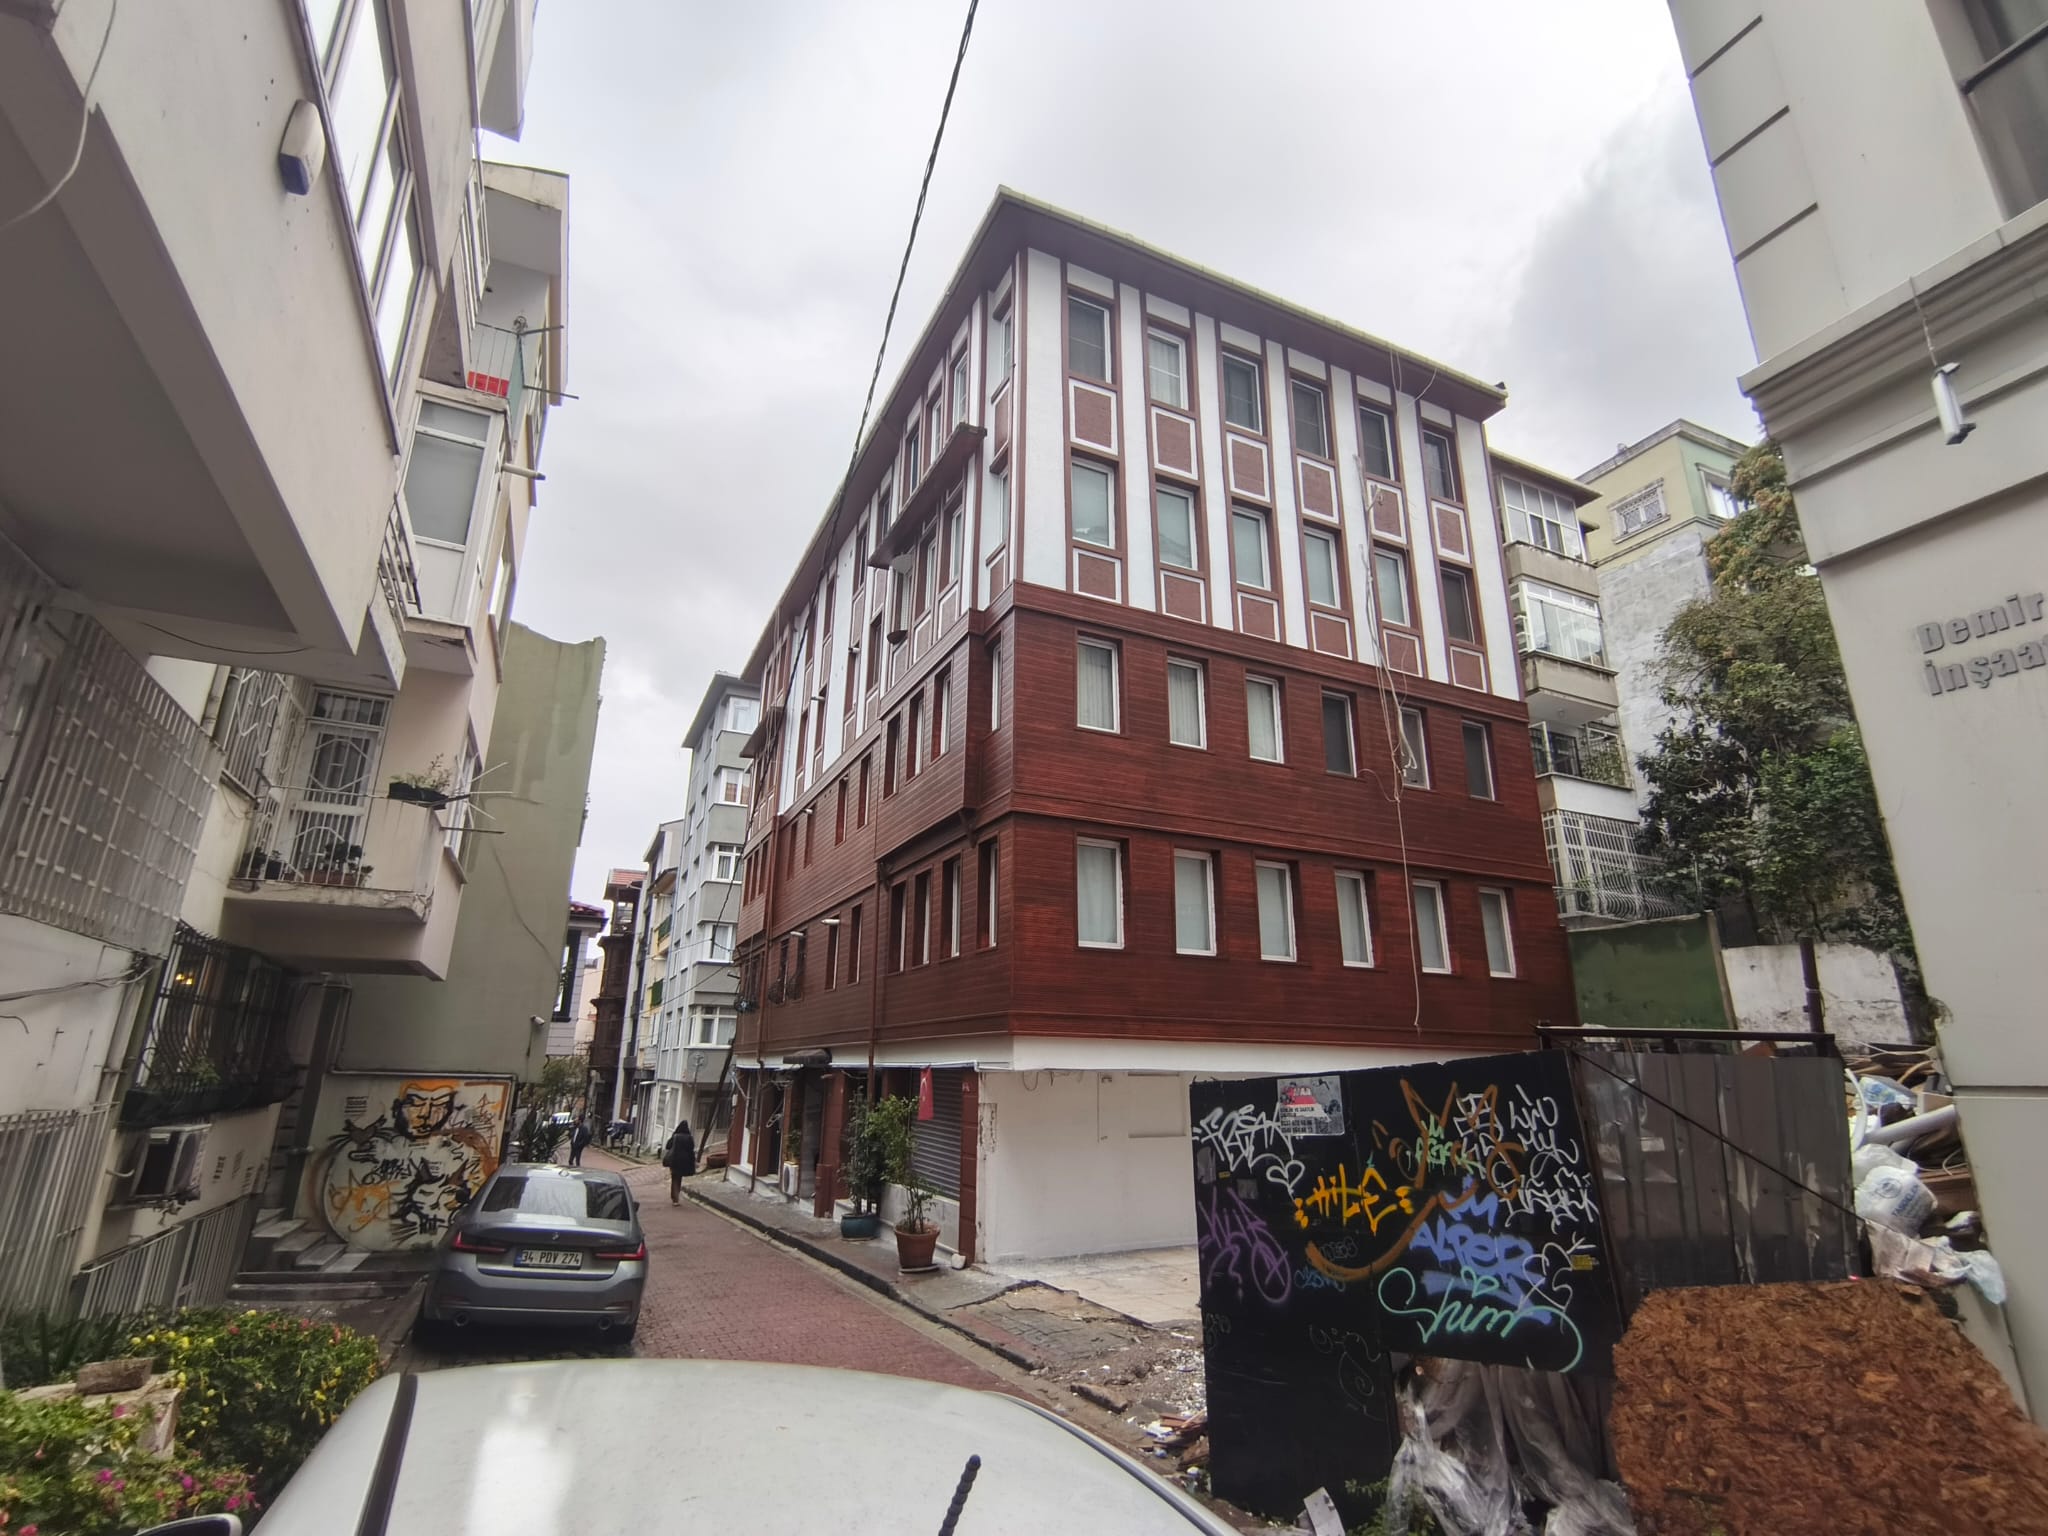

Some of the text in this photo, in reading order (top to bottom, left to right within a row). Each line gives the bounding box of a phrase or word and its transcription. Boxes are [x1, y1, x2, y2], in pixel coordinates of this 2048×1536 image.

[1917, 592, 2045, 655] Demir
[522, 1250, 580, 1265] 34 PDV 274
